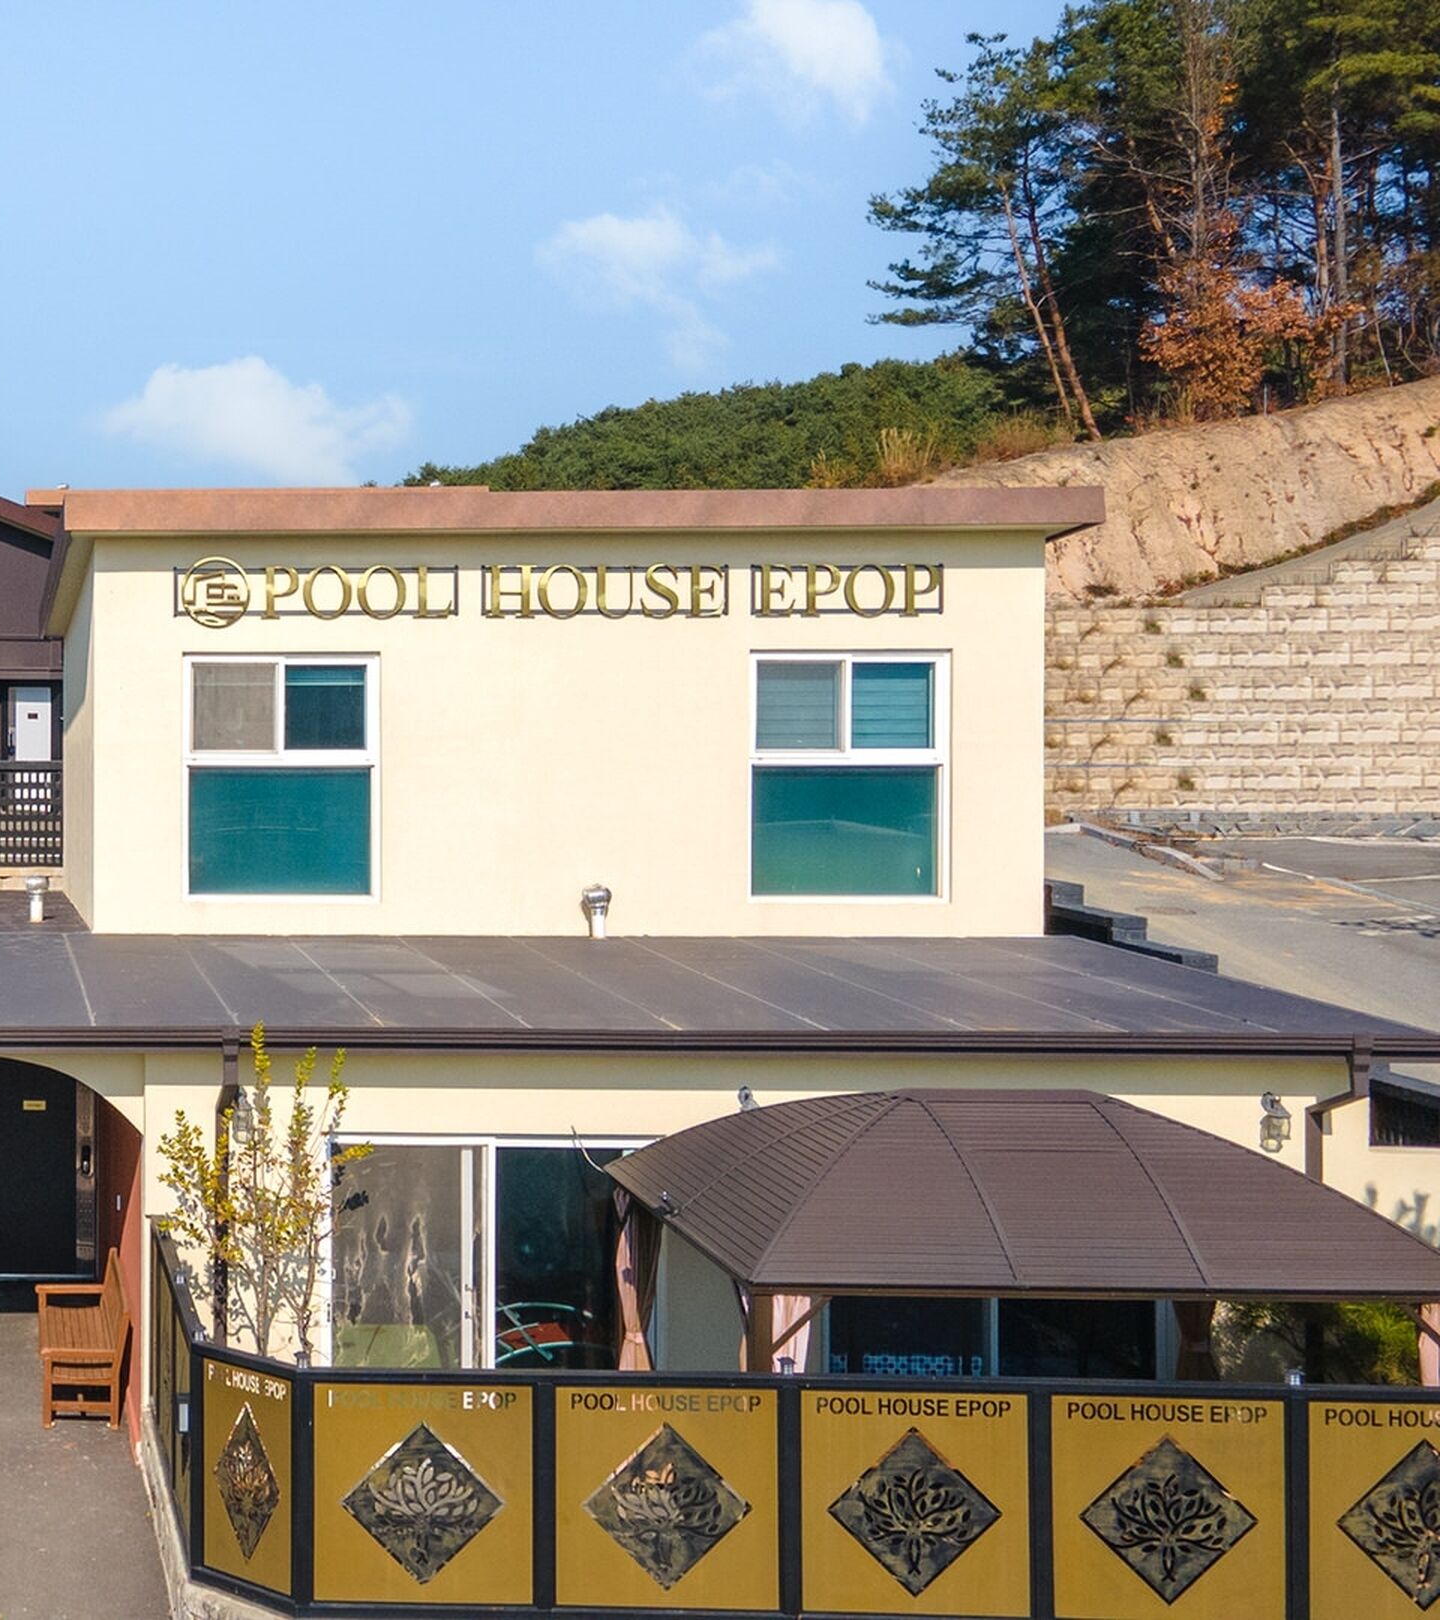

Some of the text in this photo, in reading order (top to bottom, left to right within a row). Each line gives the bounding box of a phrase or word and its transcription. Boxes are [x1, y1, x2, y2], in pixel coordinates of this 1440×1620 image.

[261, 563, 942, 620] POOL HOUSE EPOP
[463, 1391, 517, 1409] EPOP
[571, 1393, 761, 1412] POOL HOUSE EPOP
[816, 1397, 1011, 1417] POOL HOUSE EPOP
[1067, 1402, 1268, 1423] POOL HOUSE EPOP
[1325, 1408, 1383, 1426] POOL
